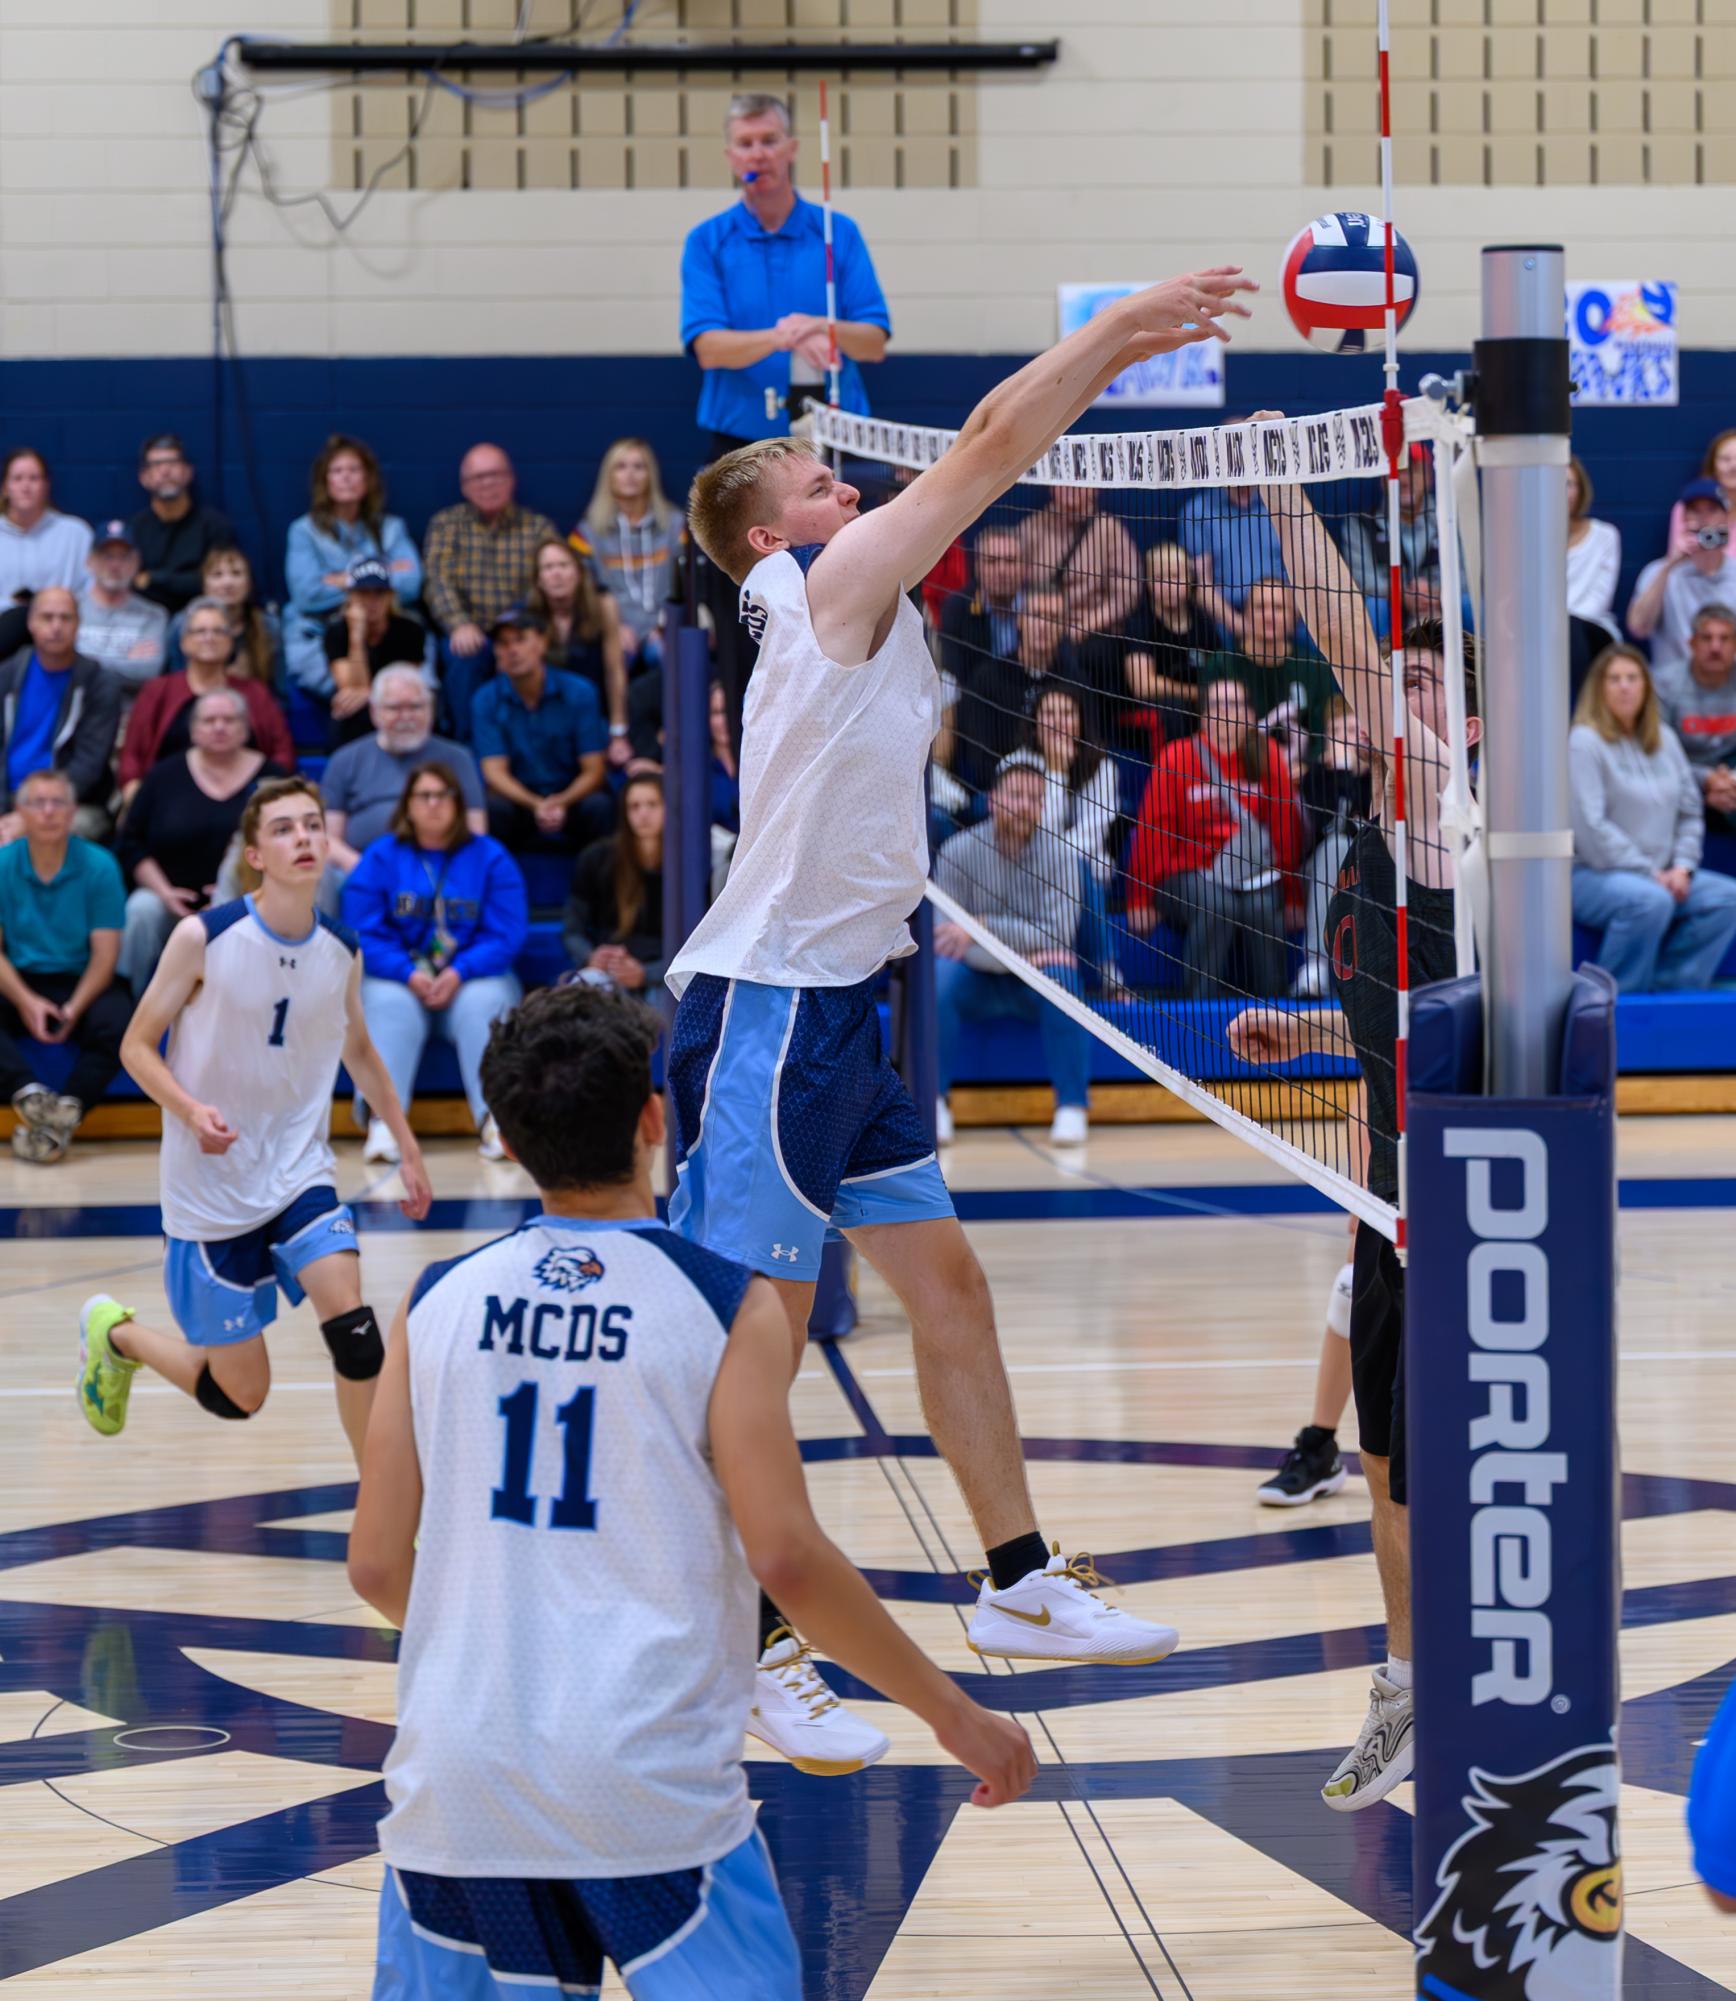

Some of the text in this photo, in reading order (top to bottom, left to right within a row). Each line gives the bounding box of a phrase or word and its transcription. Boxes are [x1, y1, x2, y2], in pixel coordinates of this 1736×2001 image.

[268, 998, 290, 1047] 1
[478, 1296, 632, 1362] MCDS
[490, 1381, 598, 1531] 11
